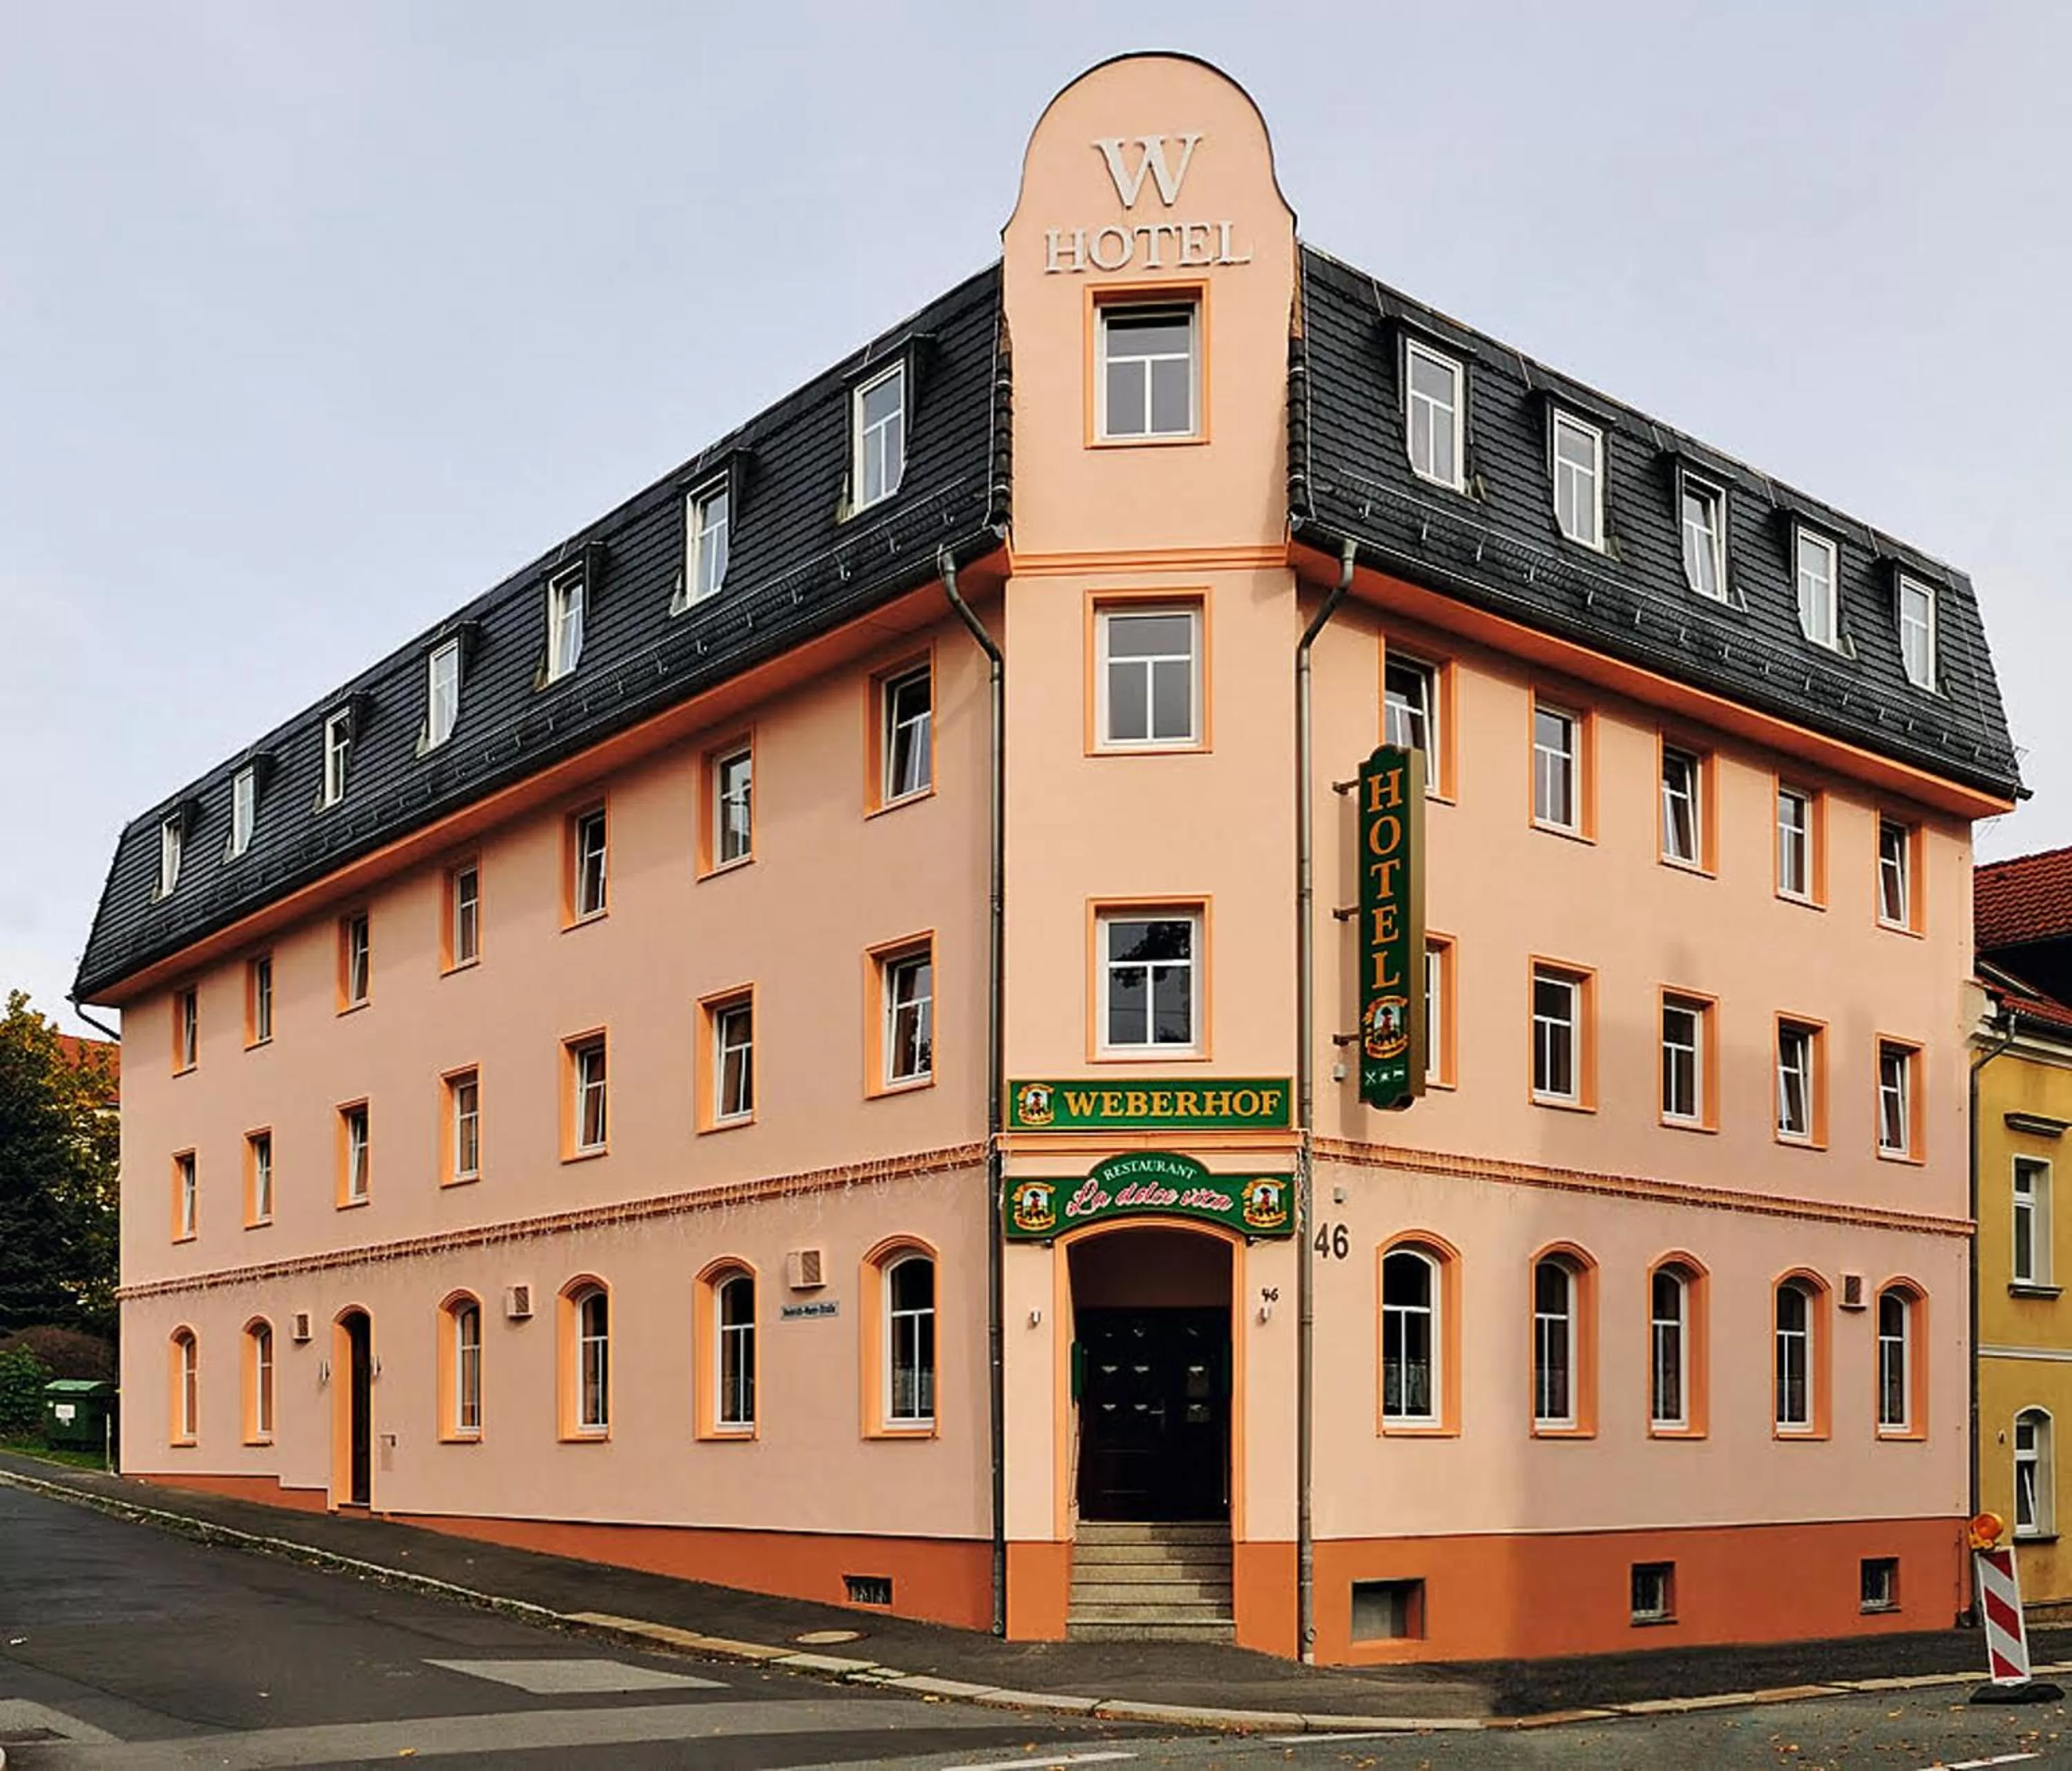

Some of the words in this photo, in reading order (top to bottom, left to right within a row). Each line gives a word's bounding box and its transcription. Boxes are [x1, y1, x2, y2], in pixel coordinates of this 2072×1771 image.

[1091, 133, 1204, 209] W
[1044, 220, 1251, 274] HOTEL
[1368, 768, 1403, 990] HOTEL
[1063, 1090, 1282, 1117] WEBERHOF
[1103, 1160, 1198, 1180] RESTAURANT
[1066, 1178, 1112, 1216] La
[1115, 1181, 1179, 1206] dolce
[1179, 1187, 1234, 1211] vita
[1314, 1223, 1349, 1260] 46
[1261, 1287, 1278, 1302] 46
